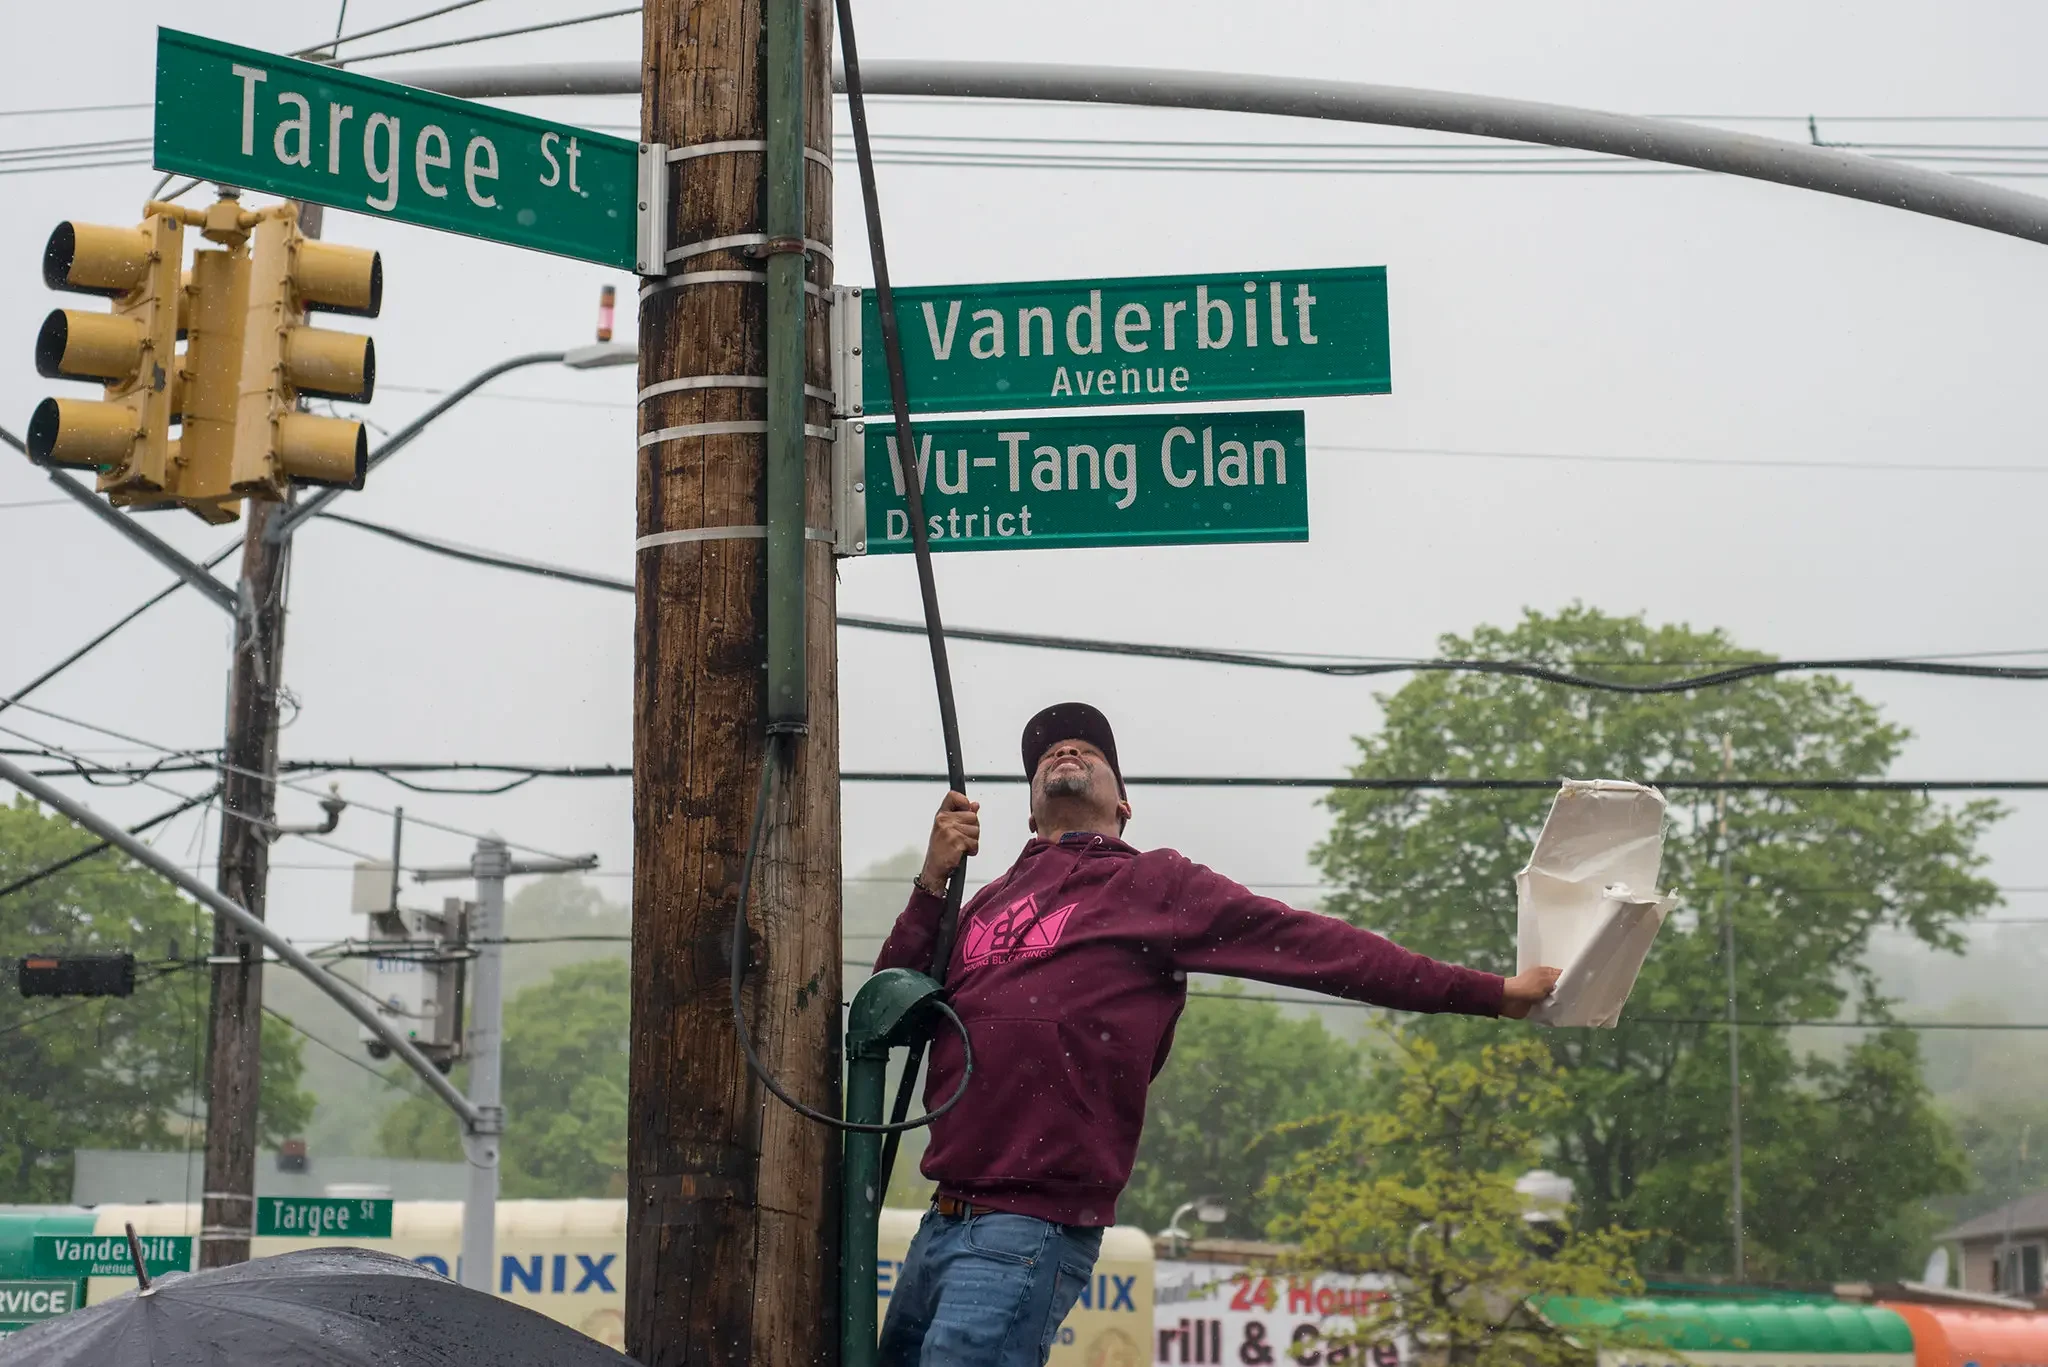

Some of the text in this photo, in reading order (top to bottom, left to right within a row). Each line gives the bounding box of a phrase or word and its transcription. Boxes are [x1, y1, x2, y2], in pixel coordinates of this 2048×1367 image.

[232, 63, 582, 213] Targee St
[921, 281, 1319, 362] Vanderbilt
[1051, 366, 1190, 397] Avenue
[886, 426, 1287, 510] Wu-Tang Clan
[886, 505, 1033, 541] Dstrict
[273, 1200, 375, 1237] Targee St
[91, 1263, 135, 1274] Avenue
[0, 1290, 66, 1313] VICE
[1230, 1272, 1274, 1312] 24
[1240, 1321, 1274, 1365] &
